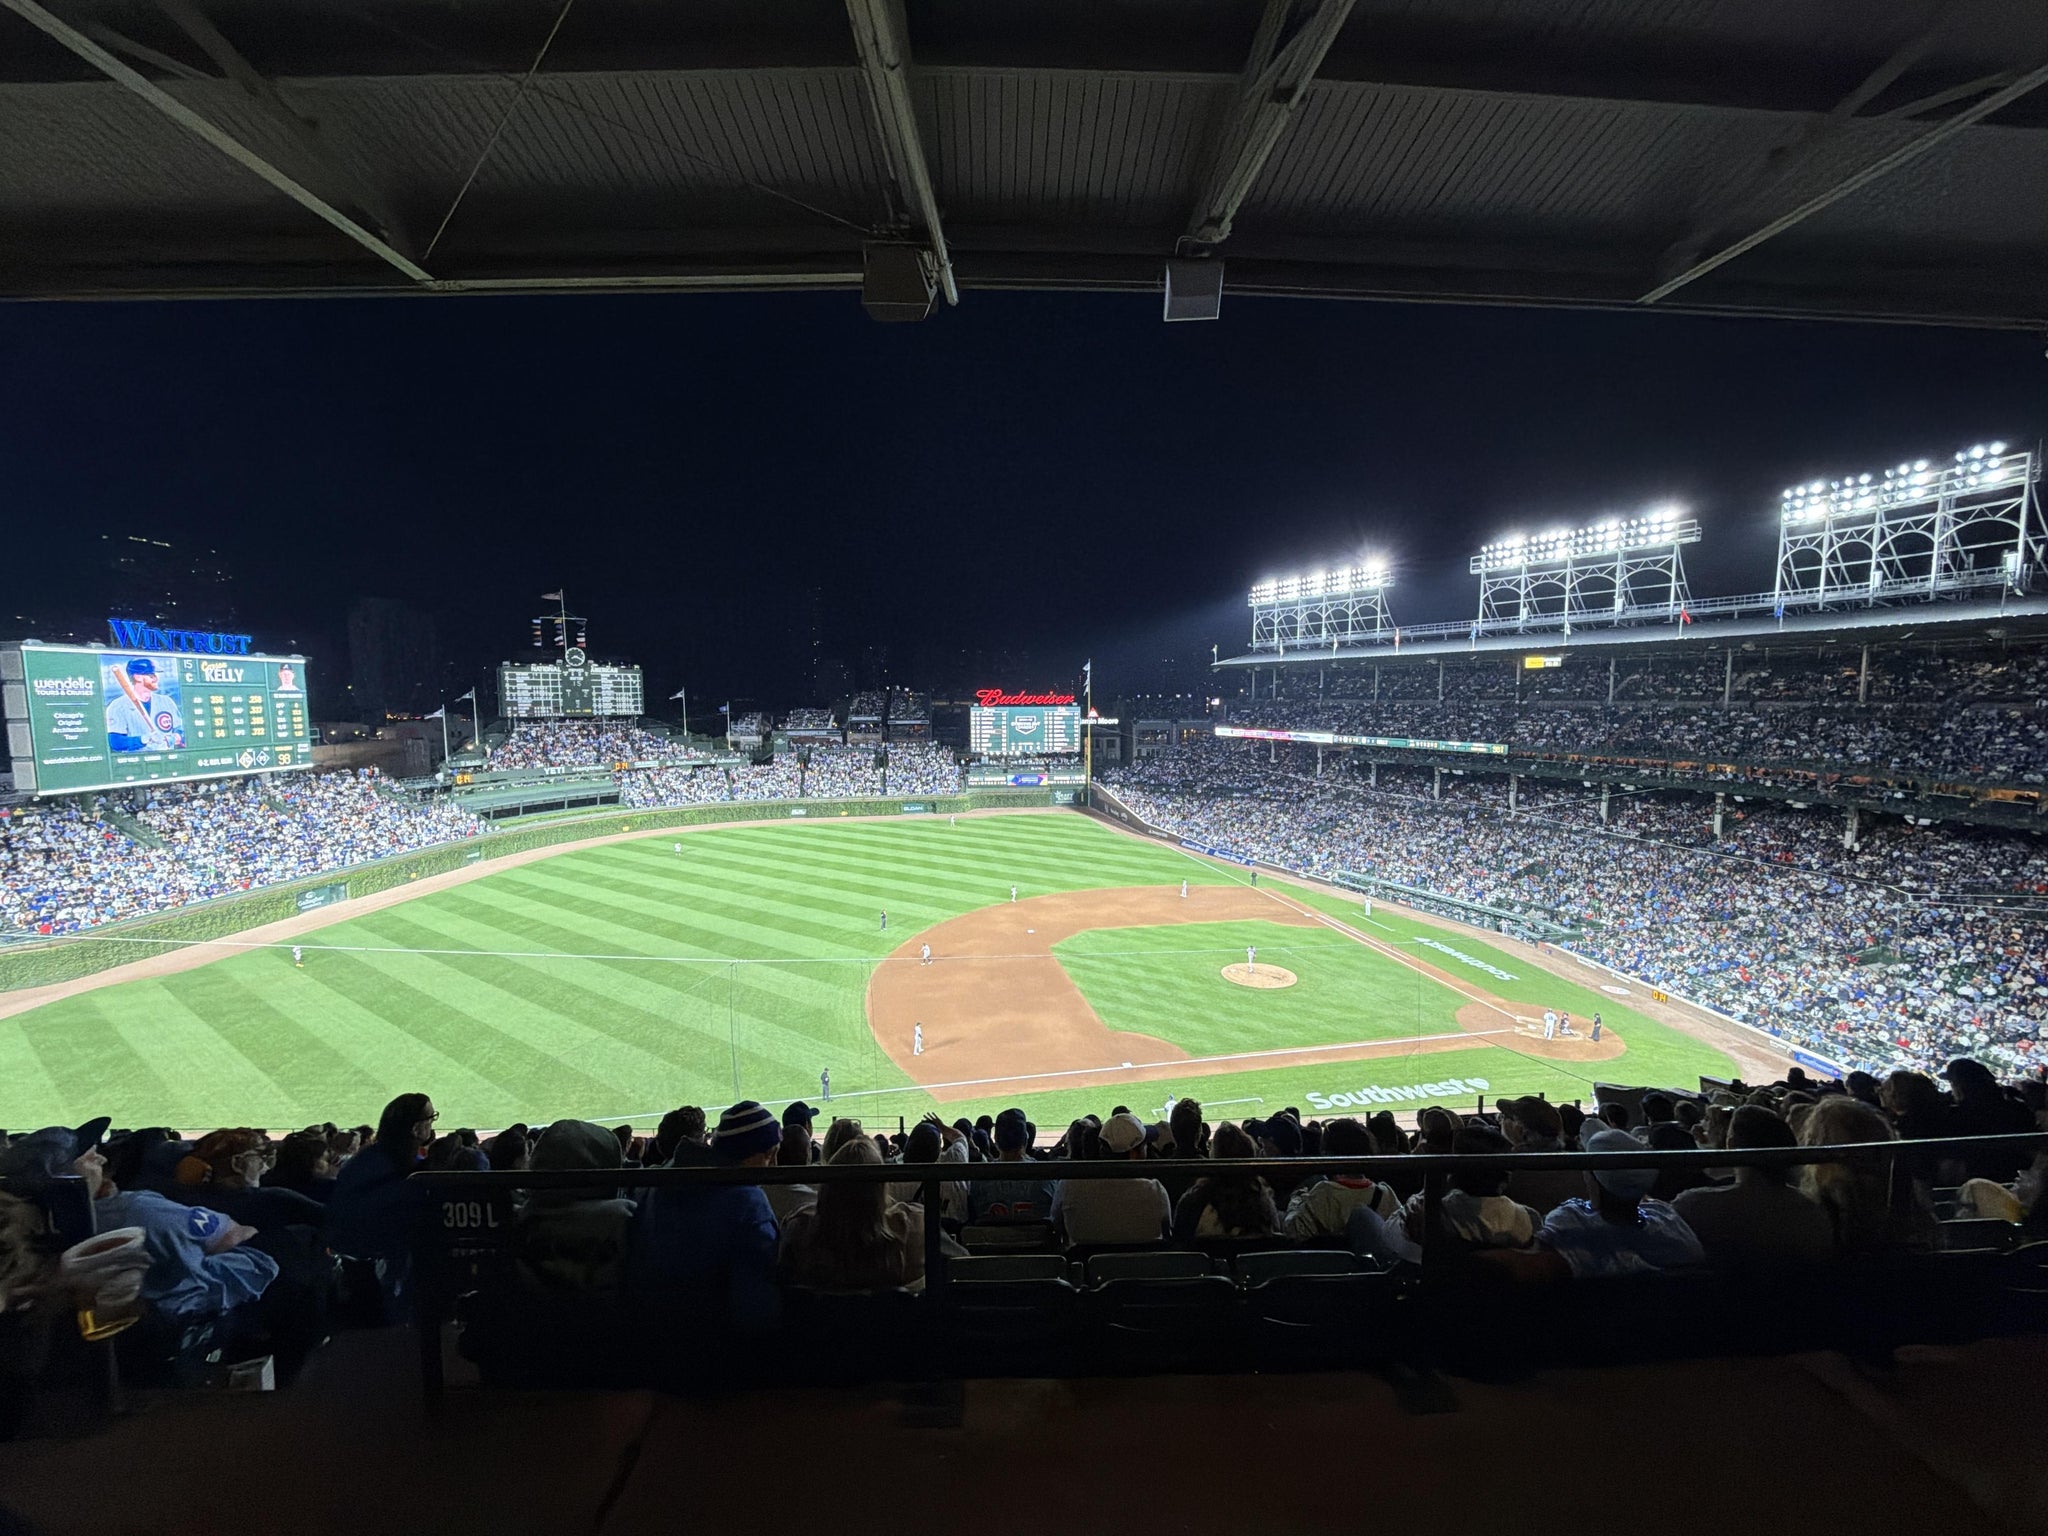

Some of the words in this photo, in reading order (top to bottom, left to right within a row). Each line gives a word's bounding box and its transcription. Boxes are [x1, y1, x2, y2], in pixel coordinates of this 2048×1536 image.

[108, 618, 252, 655] WINTRUST
[205, 668, 244, 683] KELLY
[976, 689, 1074, 706] Budweiser
[544, 767, 565, 775] YETI
[1305, 1078, 1477, 1110] Southwest
[442, 1201, 482, 1228] 309
